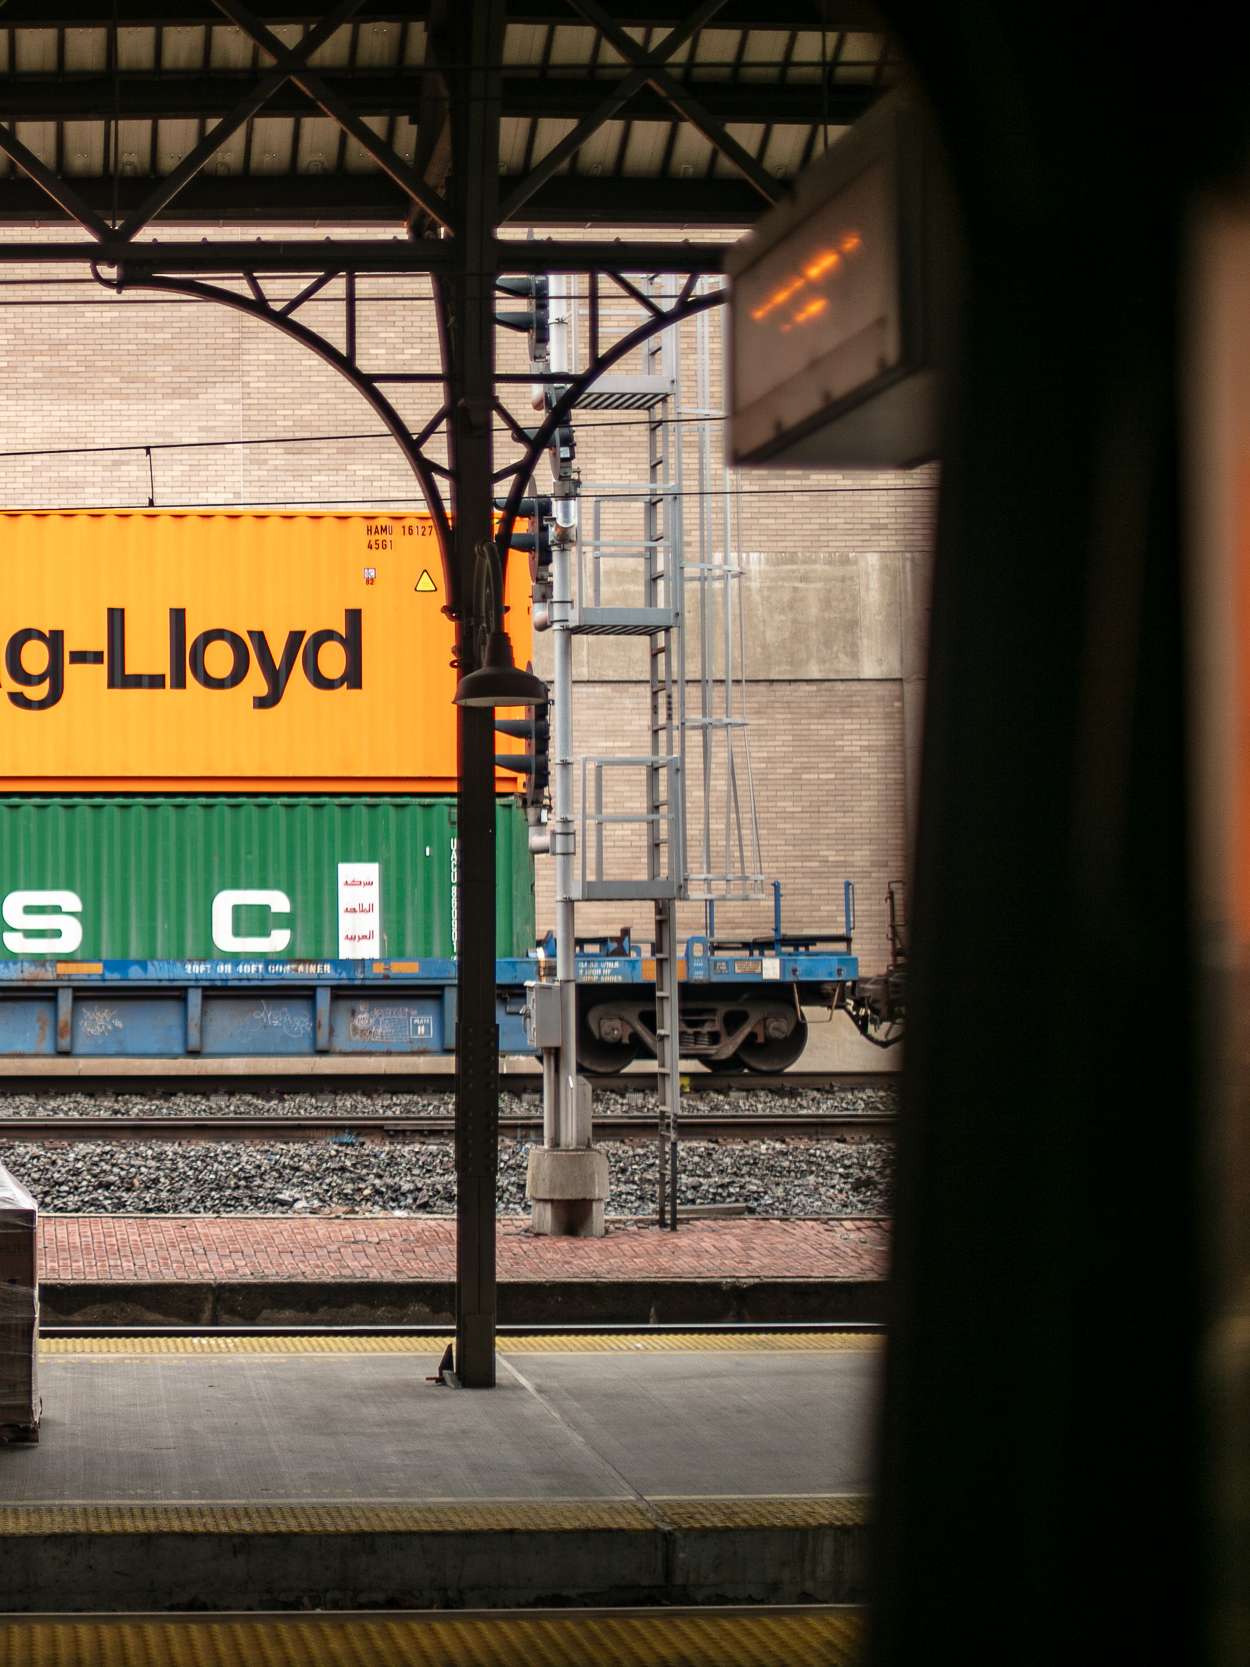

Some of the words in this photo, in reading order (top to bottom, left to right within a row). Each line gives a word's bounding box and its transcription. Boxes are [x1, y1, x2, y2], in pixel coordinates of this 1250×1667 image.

[366, 525, 393, 536] HAMU
[367, 539, 393, 550] 45G1
[216, 963, 232, 975] OR
[267, 964, 331, 975] CONTAINER
